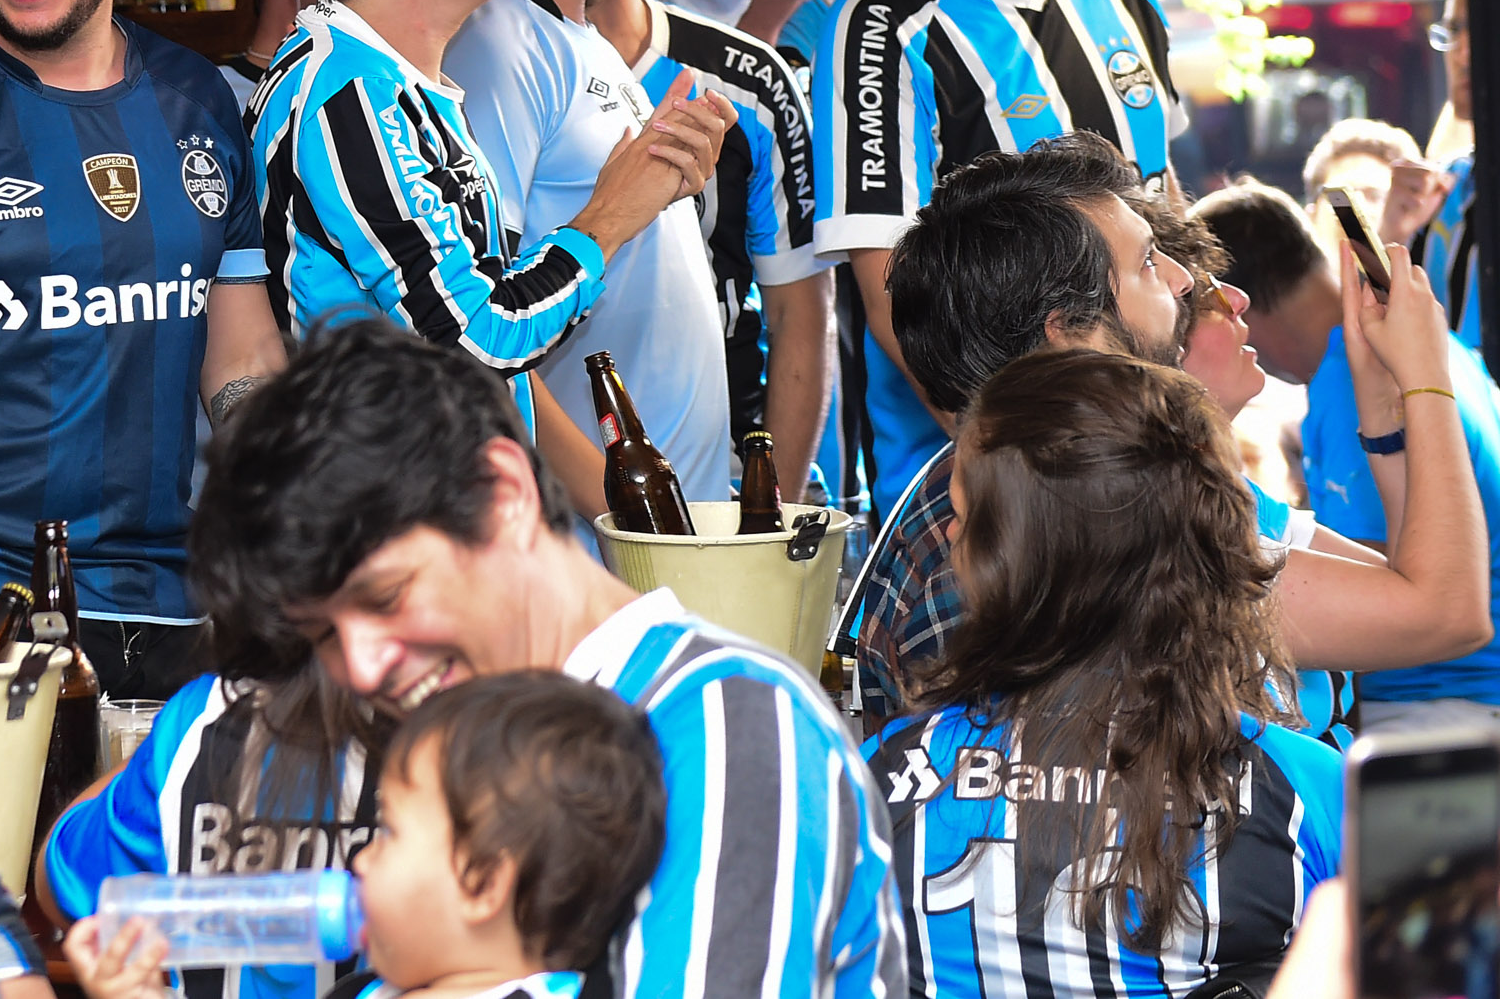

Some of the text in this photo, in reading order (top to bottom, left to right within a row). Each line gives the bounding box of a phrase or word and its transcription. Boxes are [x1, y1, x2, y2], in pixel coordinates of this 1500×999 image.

[858, 4, 892, 192] TRAMONTINA
[724, 46, 815, 219] TRAMONTINA
[90, 157, 129, 169] CAMPEÓN
[100, 192, 137, 201] LIBERTADORES
[113, 206, 129, 214] 2017
[40, 263, 213, 330] Banris
